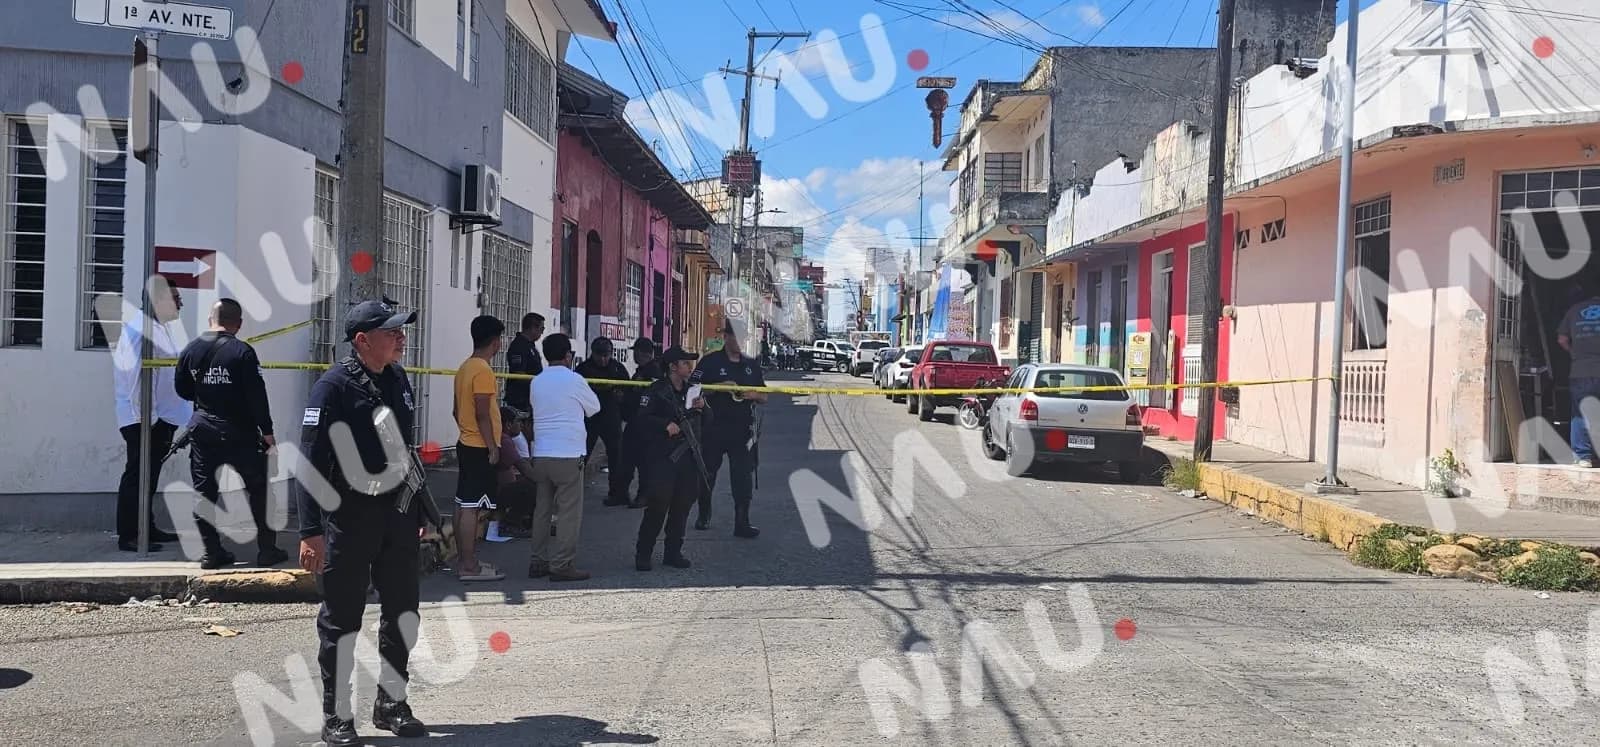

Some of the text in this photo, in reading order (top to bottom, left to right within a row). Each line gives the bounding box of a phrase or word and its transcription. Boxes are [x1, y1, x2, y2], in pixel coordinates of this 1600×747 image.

[124, 6, 217, 30] 1ª AV. NTE.
[190, 365, 231, 382] PICÍA
[202, 375, 233, 385] NICIPAL
